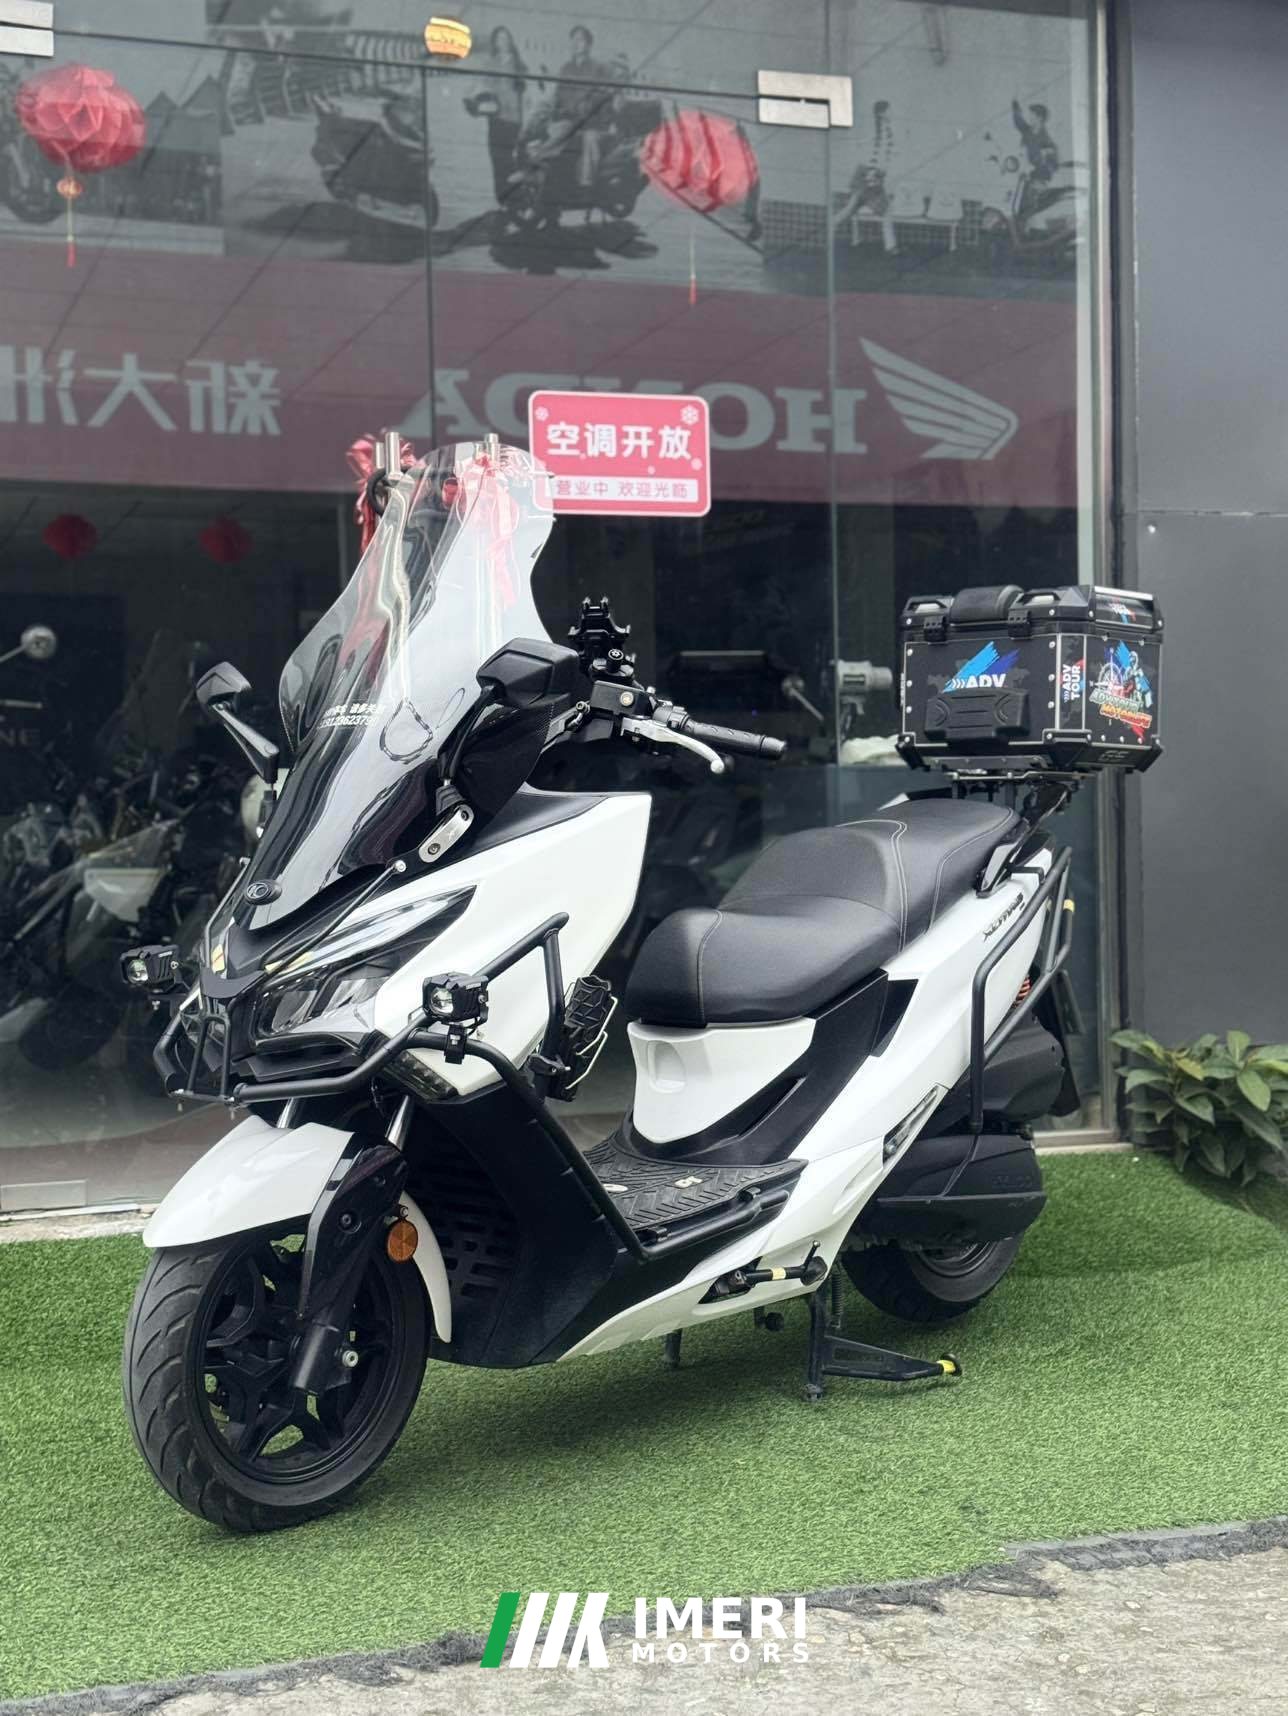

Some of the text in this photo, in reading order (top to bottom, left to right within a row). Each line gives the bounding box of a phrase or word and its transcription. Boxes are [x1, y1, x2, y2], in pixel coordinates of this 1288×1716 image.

[546, 421, 692, 460] 空调开放
[556, 480, 609, 496] 营业中
[966, 673, 1006, 688] ADV
[1062, 664, 1071, 691] ADV
[1071, 665, 1081, 700] TOUR
